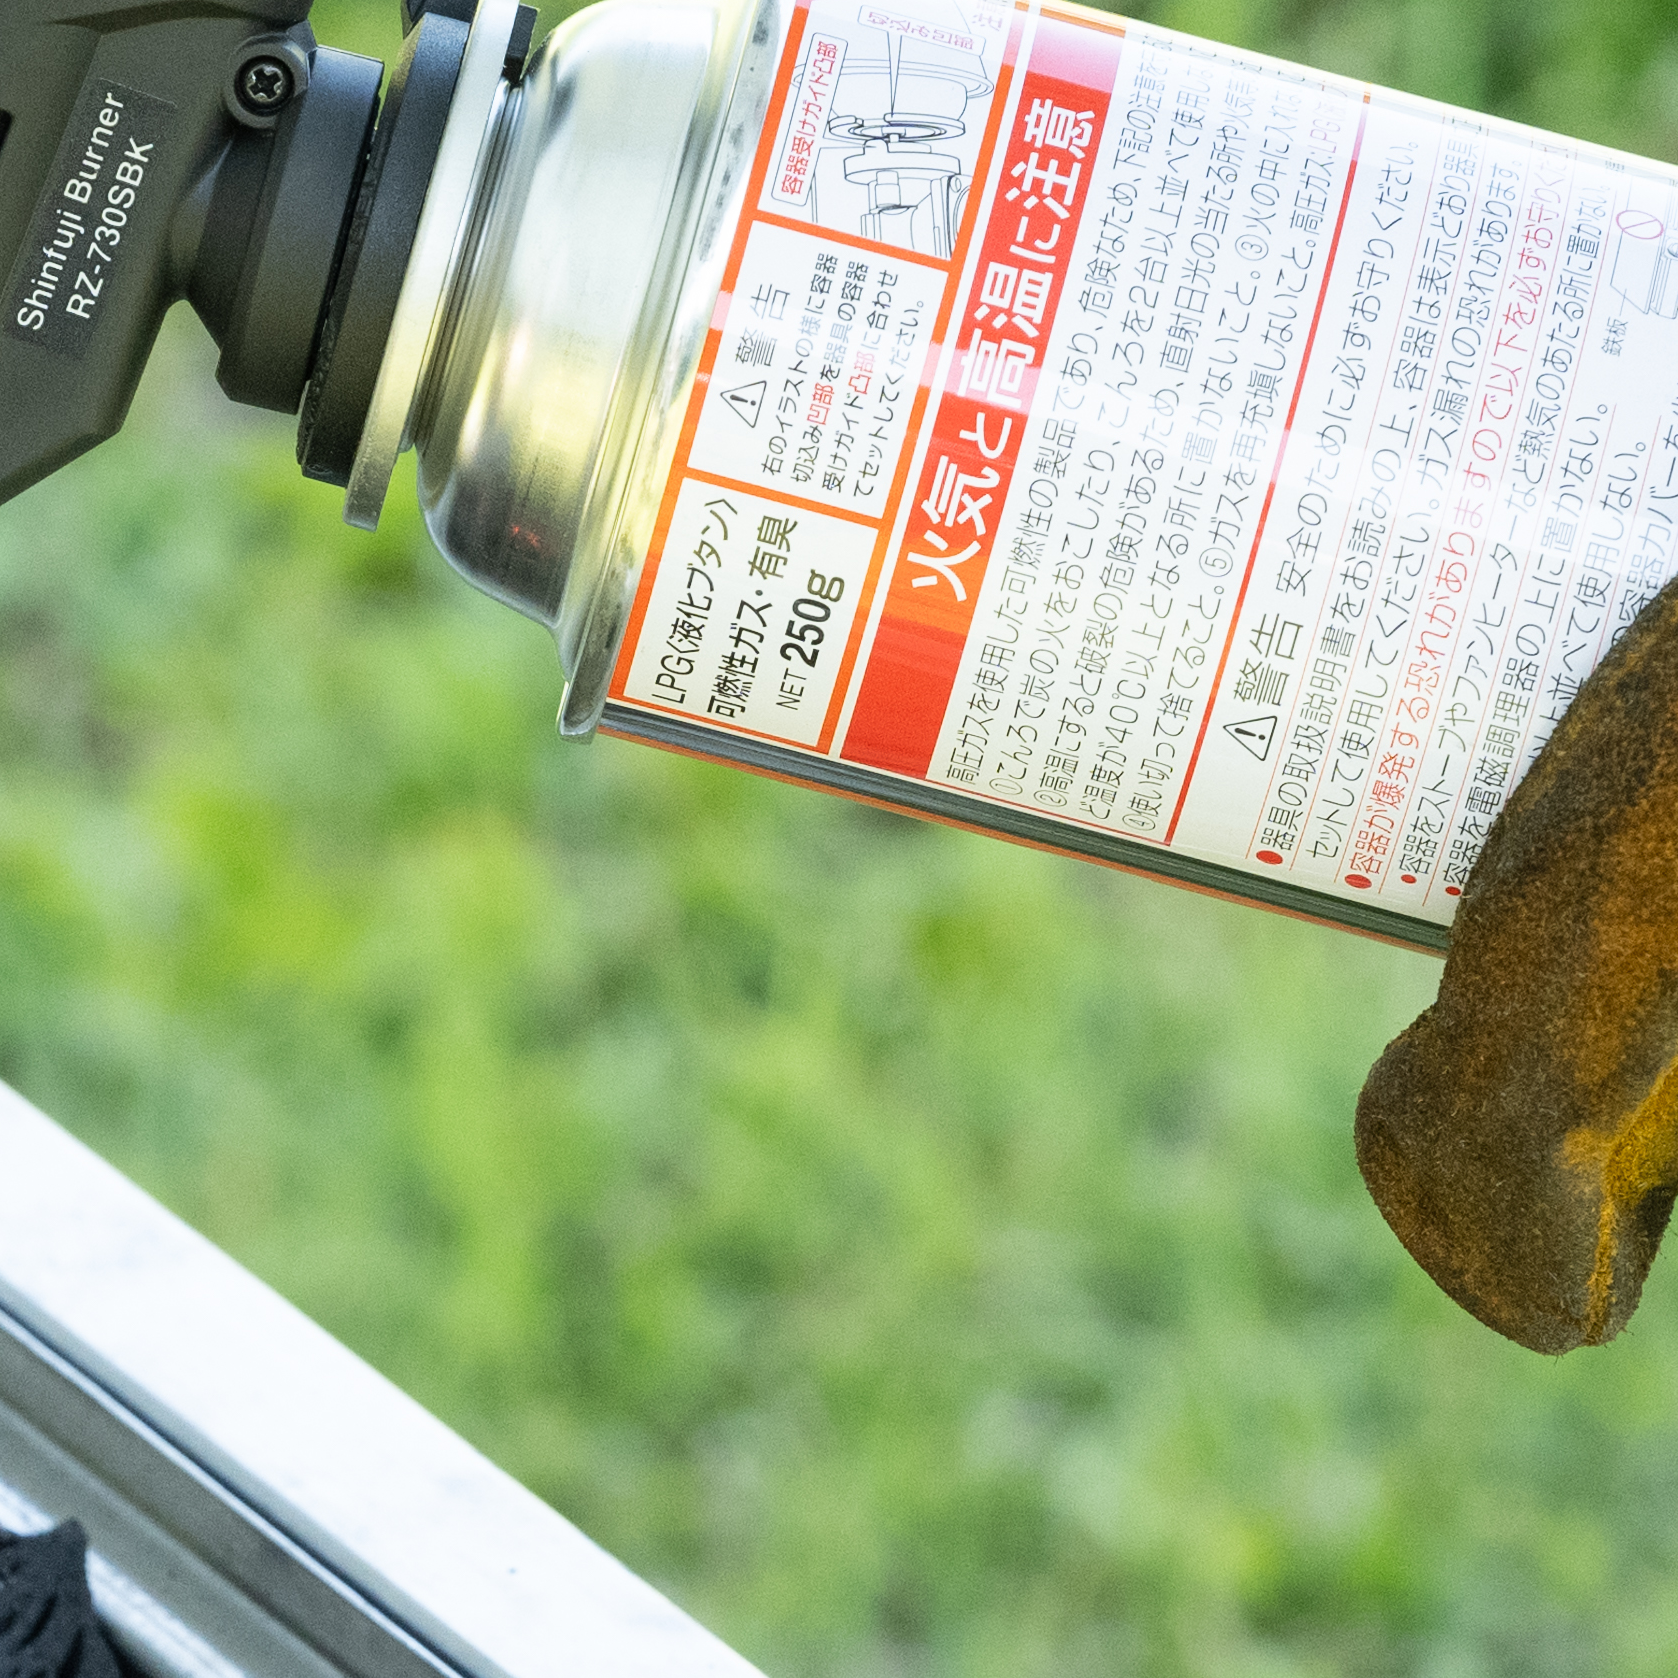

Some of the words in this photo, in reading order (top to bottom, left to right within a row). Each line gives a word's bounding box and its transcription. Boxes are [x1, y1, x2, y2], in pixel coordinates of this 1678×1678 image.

[17, 207, 89, 330] Shinfuji
[64, 91, 125, 200] Burner
[778, 38, 841, 198] 容器受けガイド凸部
[66, 135, 156, 320] RZ-730SBK
[731, 278, 792, 372] 警告
[758, 249, 840, 479] 右のイラストの様に容器
[788, 257, 871, 487] 切込み凹部を器具の容器
[819, 266, 901, 495] 受けガイド凸部に合わせ
[851, 297, 926, 500] てセットしてください。
[905, 92, 1099, 603] 火気と高温に注意
[1229, 605, 1306, 713] 警告
[1270, 139, 1421, 599] 安全のために必ずお守りください。
[1597, 313, 1631, 359] 鉄板
[773, 665, 810, 712] NET
[776, 565, 848, 670] 250g
[1440, 401, 1609, 888] 容器を電磁調理器の上に置かない。
